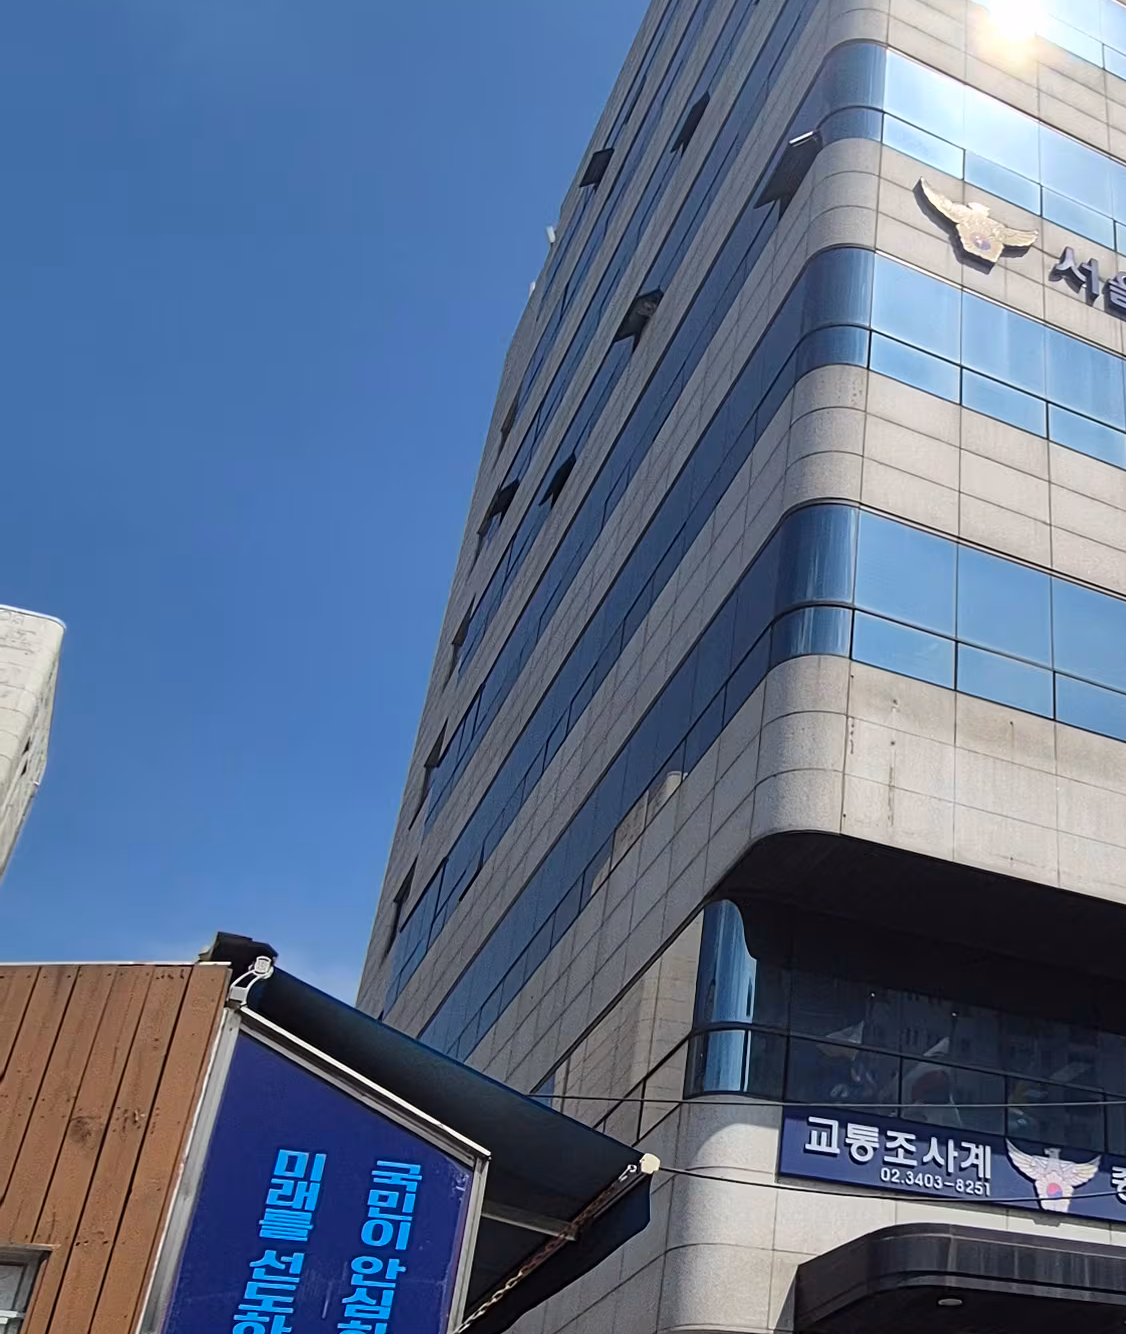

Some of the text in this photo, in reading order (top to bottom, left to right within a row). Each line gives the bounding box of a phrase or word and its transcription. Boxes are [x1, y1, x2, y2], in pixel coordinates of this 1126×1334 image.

[804, 1115, 992, 1179] 교통조사계
[880, 1167, 992, 1197] 02.3403-8251
[258, 1148, 327, 1241] 미래를
[360, 1160, 423, 1252] 국민이
